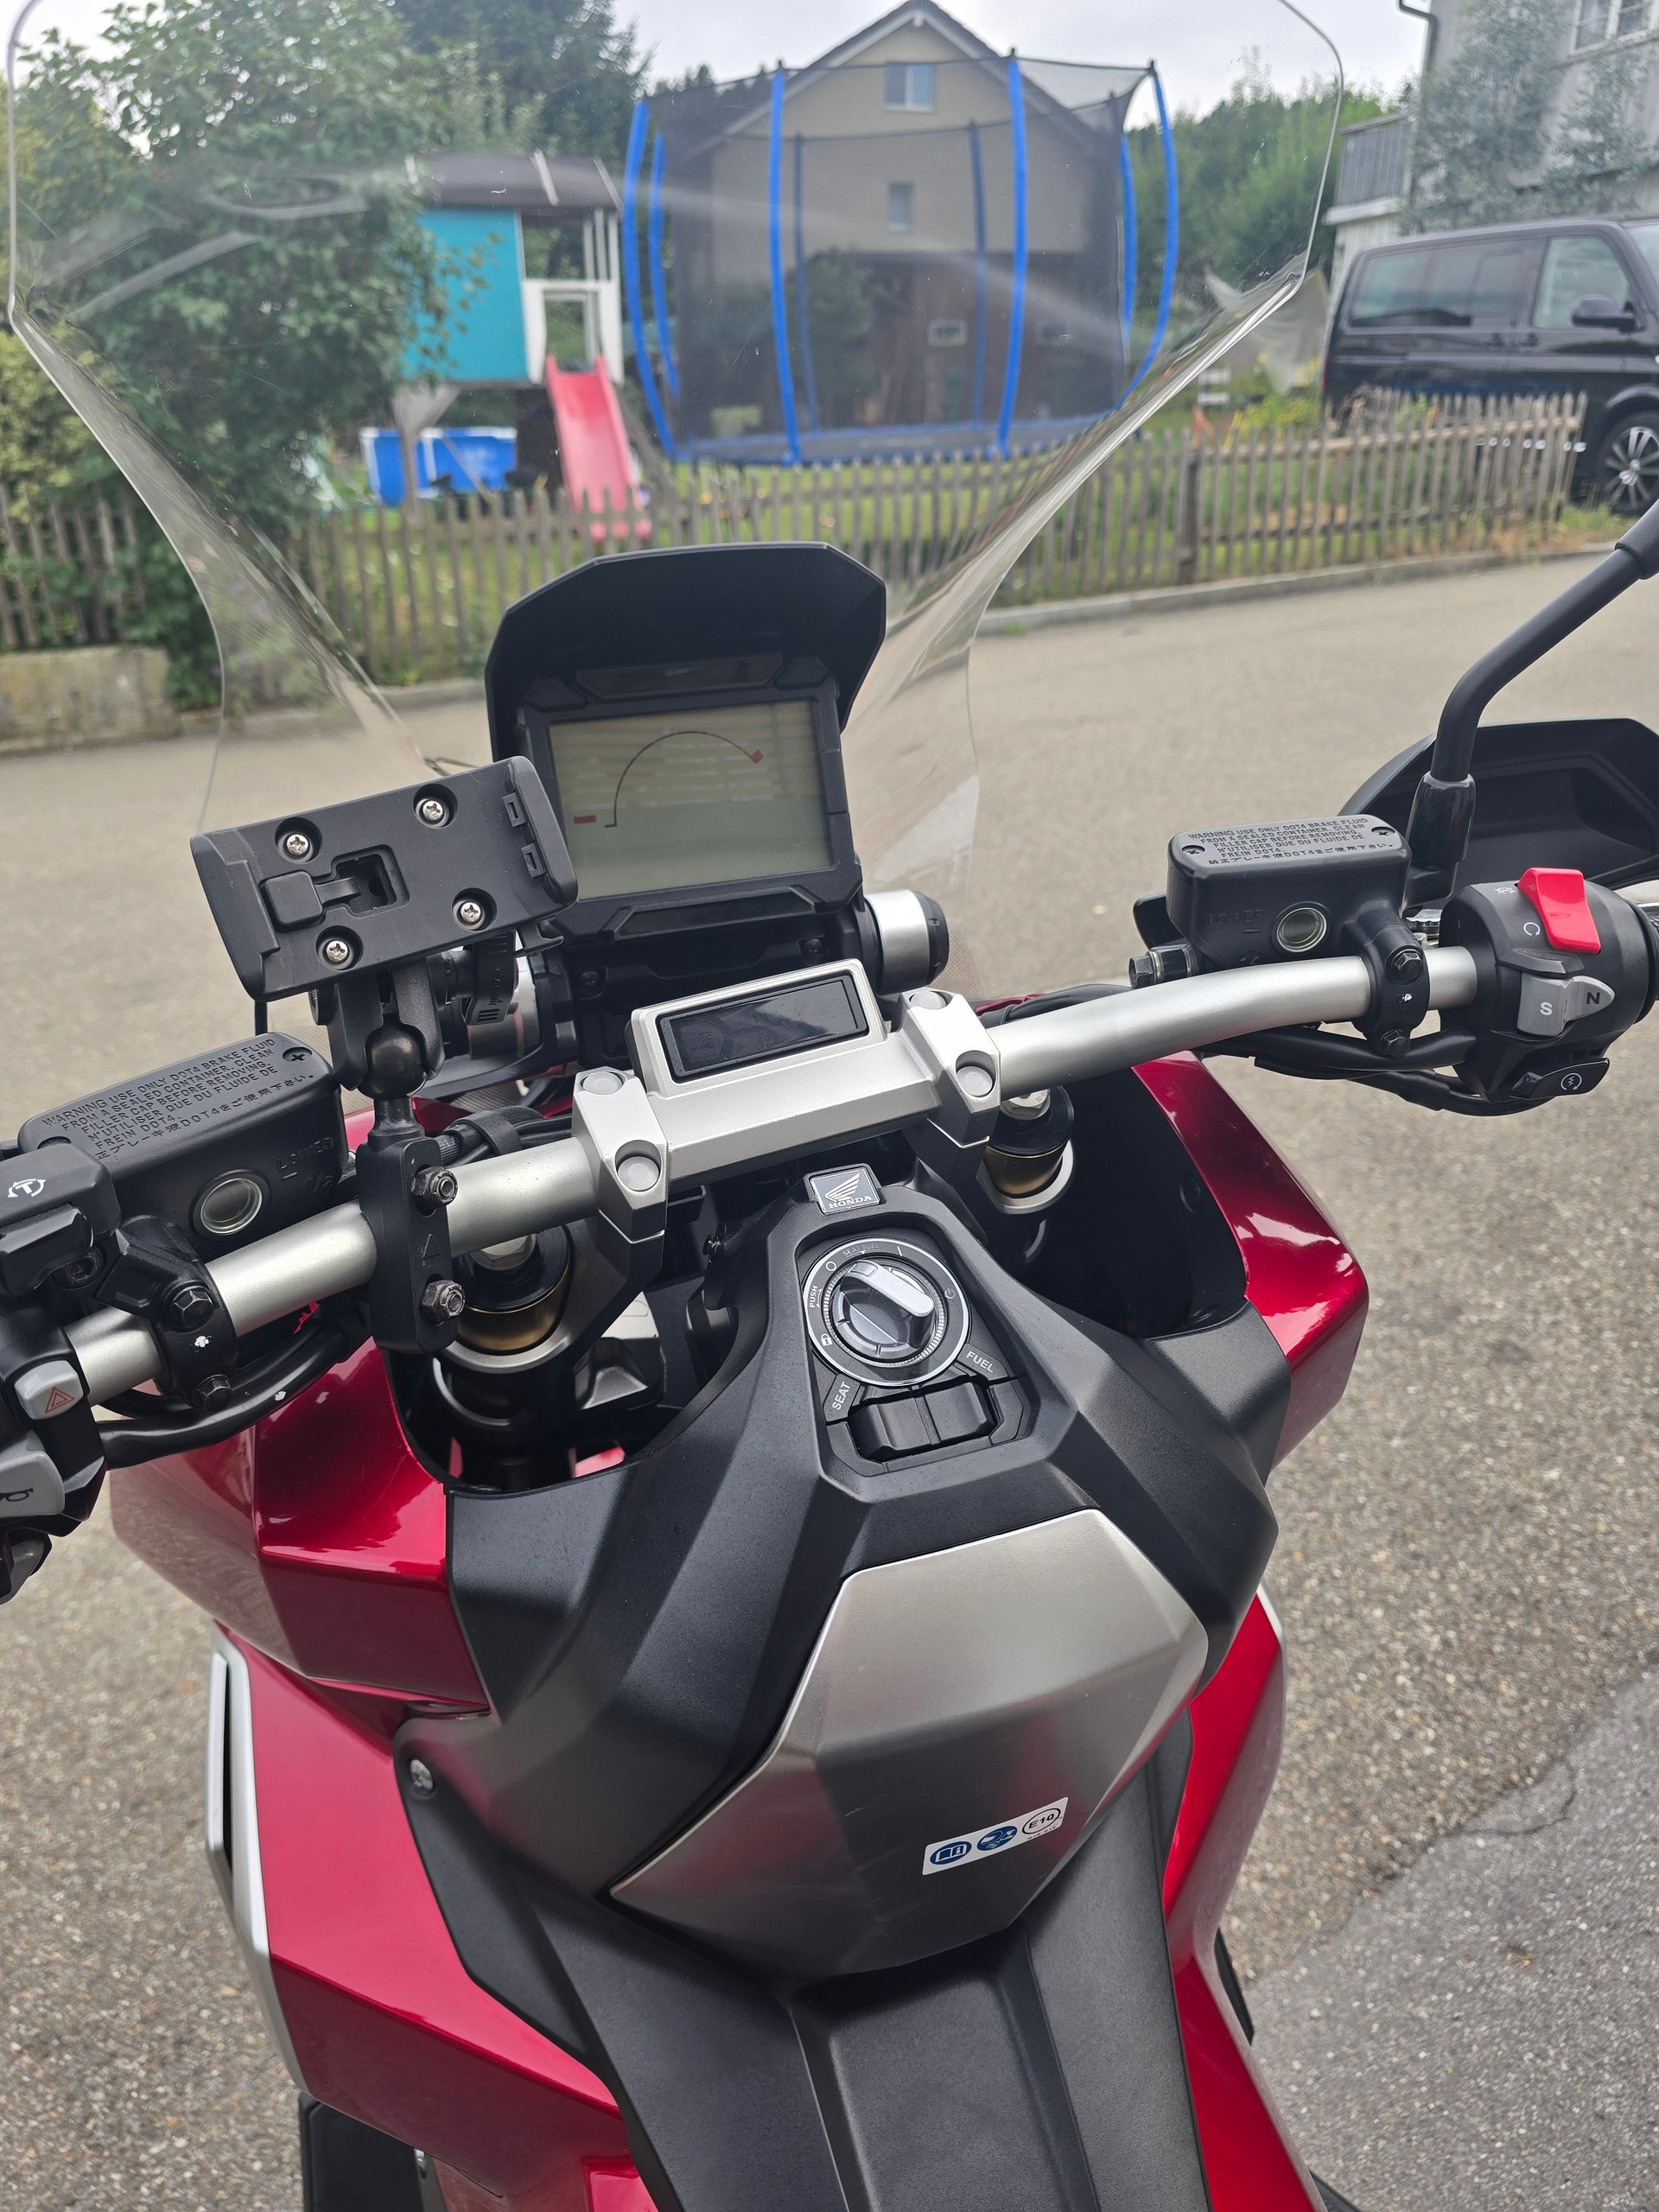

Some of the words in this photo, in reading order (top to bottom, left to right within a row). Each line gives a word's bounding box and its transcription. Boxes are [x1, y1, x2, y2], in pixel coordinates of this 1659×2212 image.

[1188, 830, 1235, 839] WARNING
[1237, 832, 1274, 841] SEALED
[1277, 827, 1332, 836] CONTAINER.
[1270, 834, 1308, 842] BEFORE
[1309, 830, 1361, 838] REMOVING.
[1217, 842, 1272, 853] N'UTILISER
[1586, 992, 1600, 1004] N
[1540, 1001, 1553, 1015] S
[42, 1099, 108, 1127] WARNING
[109, 1090, 136, 1103] USE
[138, 1077, 168, 1093] ONLY
[169, 1066, 200, 1081] DOT4
[201, 1052, 242, 1069] BRAKE
[242, 1039, 276, 1054] FLUID
[61, 1113, 99, 1131] FROM
[111, 1090, 162, 1112] SEALED
[163, 1065, 234, 1093] CONTAINER.
[235, 1049, 274, 1066] CLEAN
[81, 1111, 130, 1134] FILLER
[131, 1102, 154, 1116] CAP
[156, 1083, 204, 1105] BEFORE
[208, 1061, 270, 1086] REMOVING.
[88, 1109, 163, 1141] N'UTILISER
[166, 1097, 192, 1113] QUE
[194, 1090, 213, 1103] DU
[216, 1074, 259, 1095] FLUIDE
[259, 1066, 278, 1077] DE
[95, 1129, 137, 1149] FREIN
[140, 1115, 181, 1132] DOT4.
[828, 1196, 873, 1209] HONDA
[842, 1245, 861, 1256] SEAT
[809, 1285, 818, 1308] PUSH
[966, 1351, 994, 1373] FUEL
[832, 1381, 851, 1410] SEAT
[1028, 1814, 1055, 1828] E10
